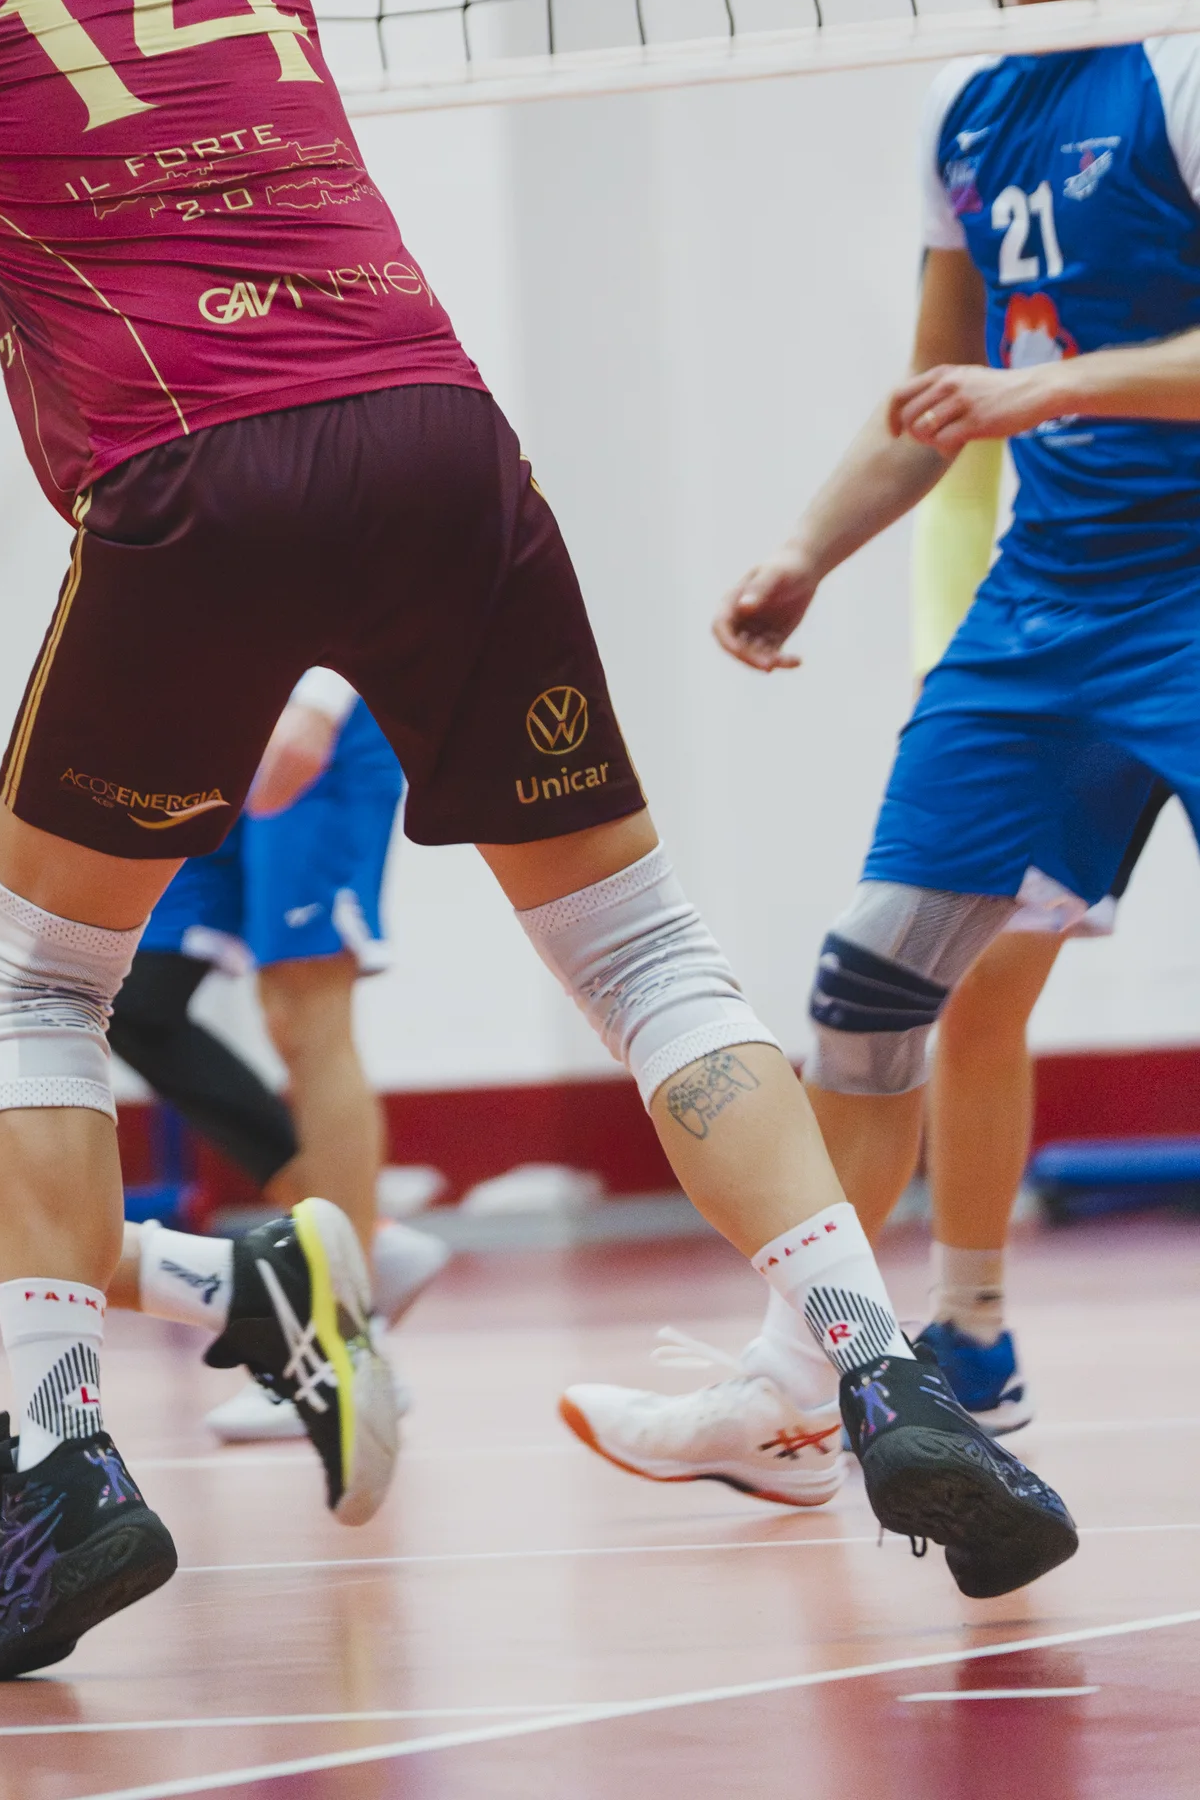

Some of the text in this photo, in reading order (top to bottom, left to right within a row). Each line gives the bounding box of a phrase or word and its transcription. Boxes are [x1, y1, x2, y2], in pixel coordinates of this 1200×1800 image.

[65, 123, 282, 201] IL FORTE
[176, 188, 254, 222] 2.0
[991, 180, 1063, 285] 21
[515, 761, 609, 804] Unicar
[828, 1322, 853, 1345] R
[80, 1386, 100, 1405] L
